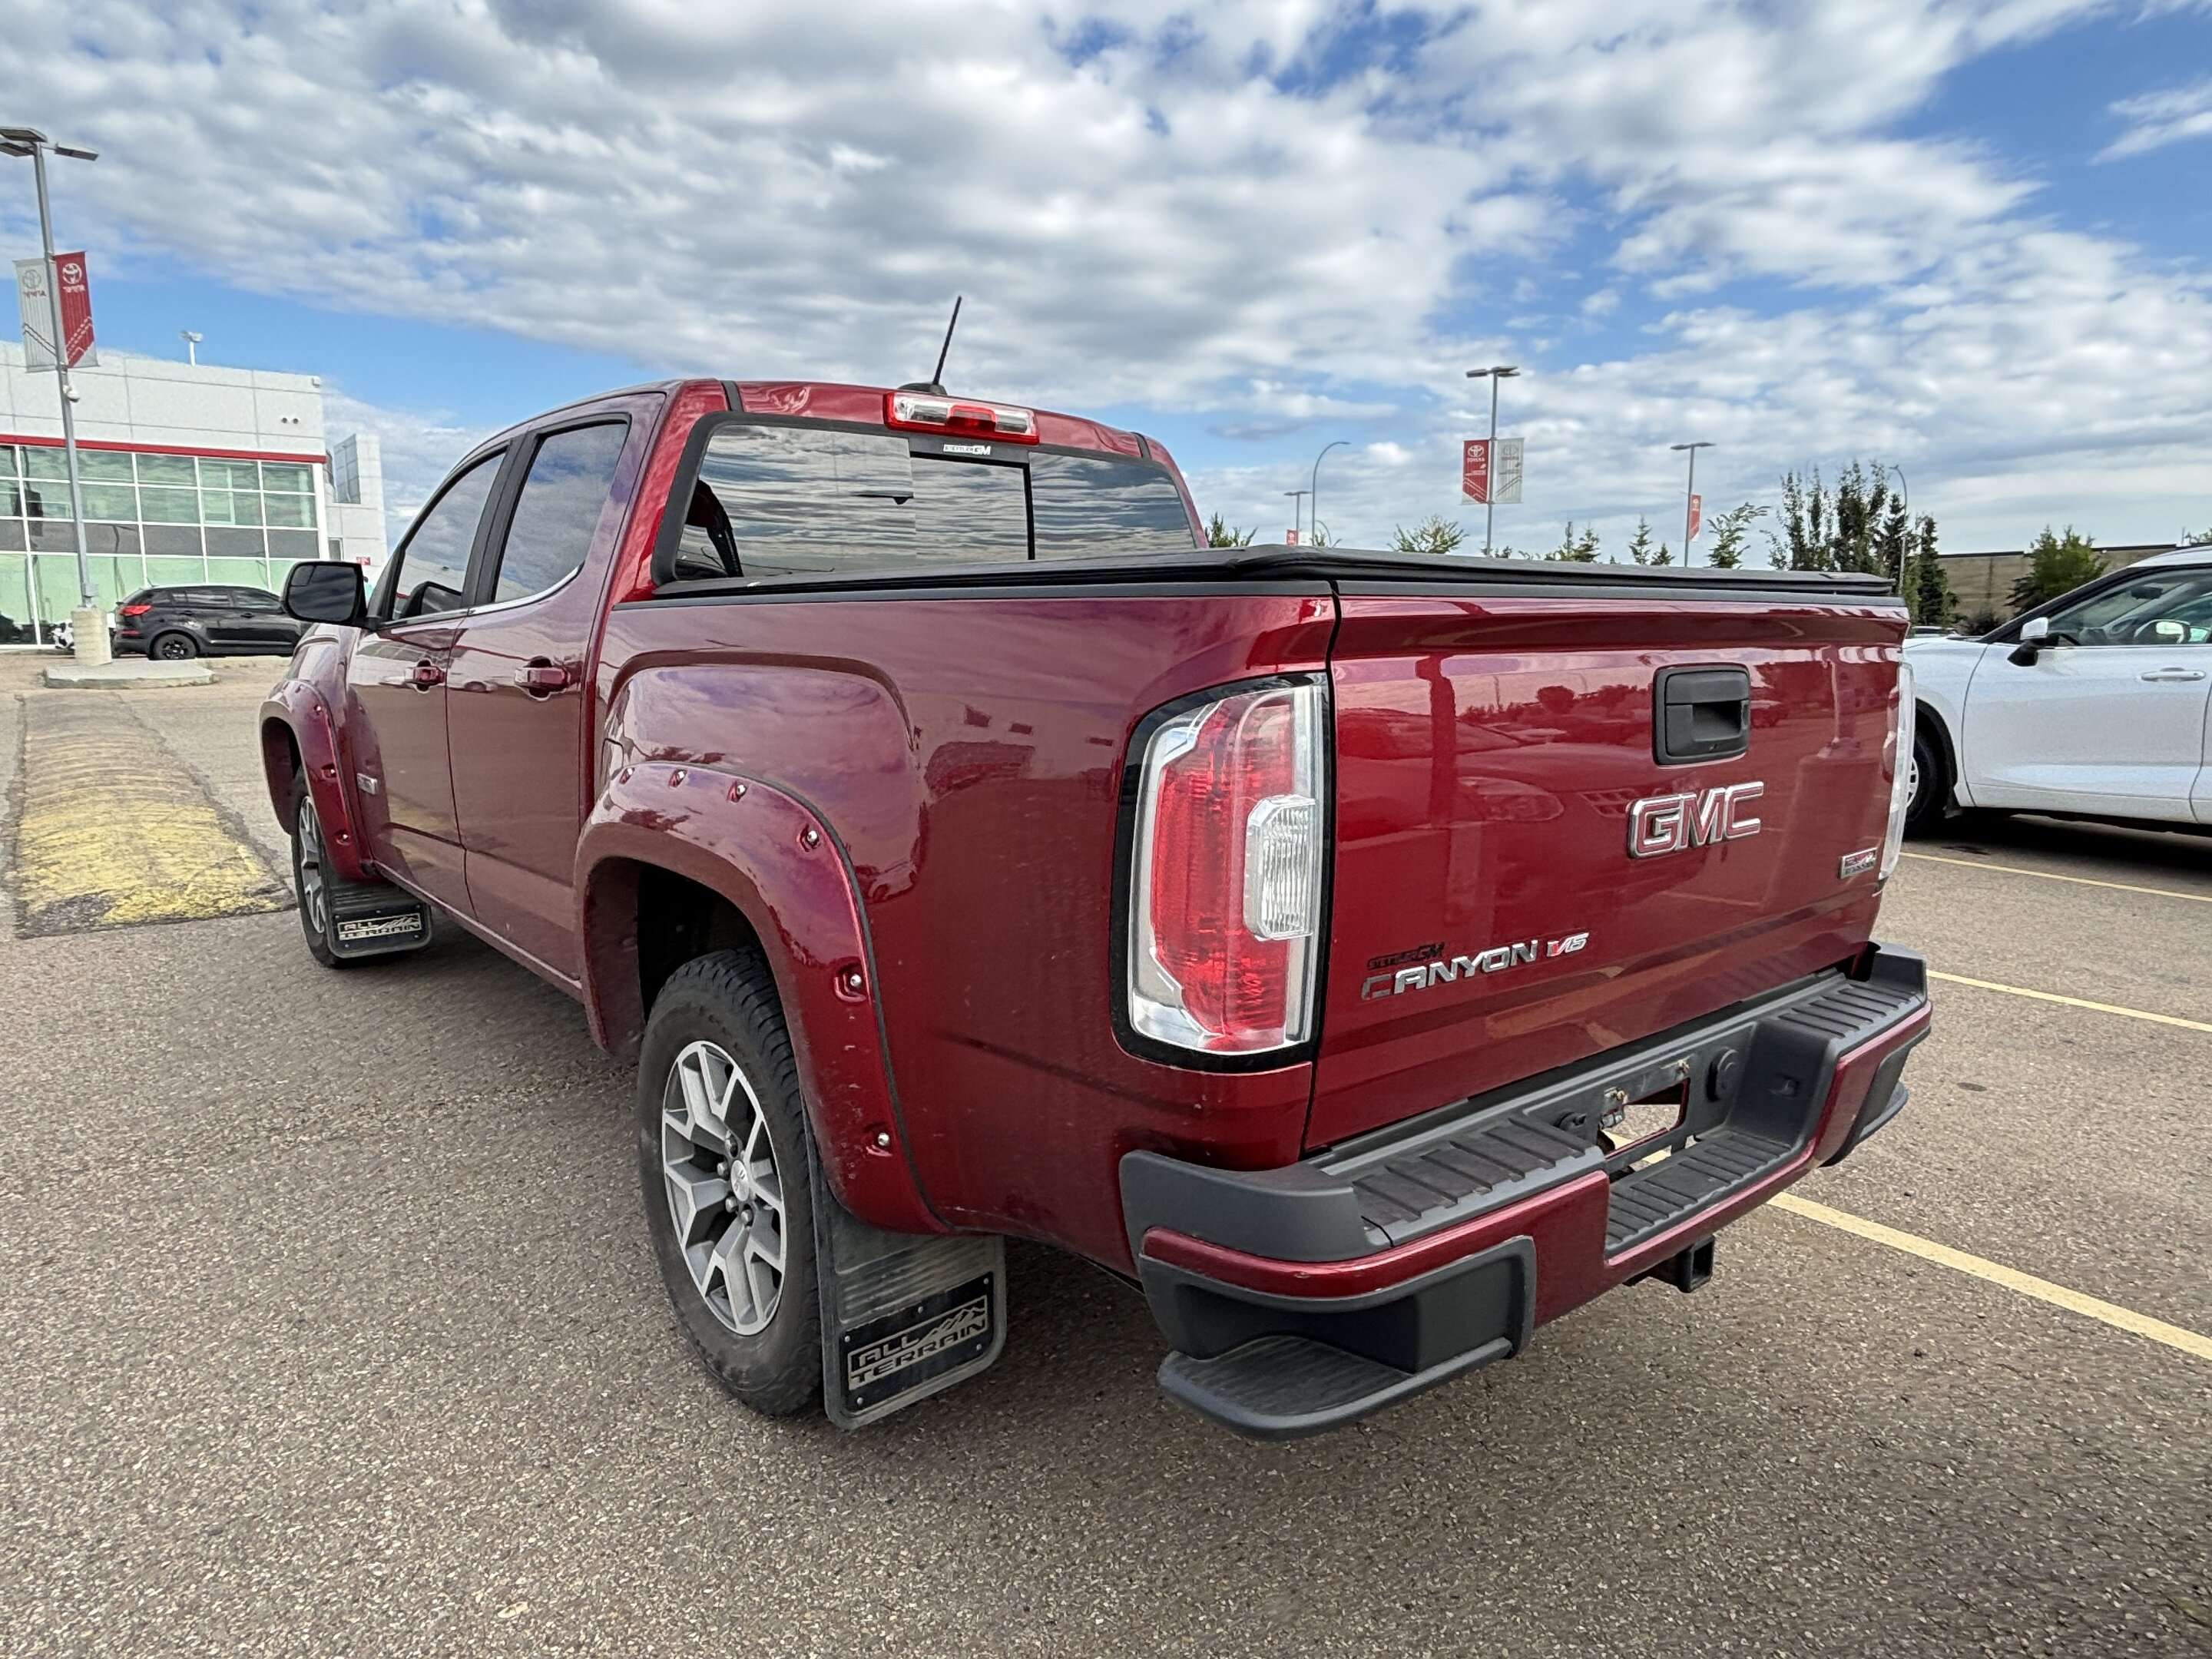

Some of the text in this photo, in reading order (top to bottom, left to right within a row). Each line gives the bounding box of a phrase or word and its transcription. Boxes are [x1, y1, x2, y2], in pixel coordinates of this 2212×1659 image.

[1628, 781, 1764, 859] GMC
[1360, 932, 1590, 1000] CANYON V6
[850, 1318, 985, 1382] TERRAIN
[859, 1335, 919, 1367] ALL
